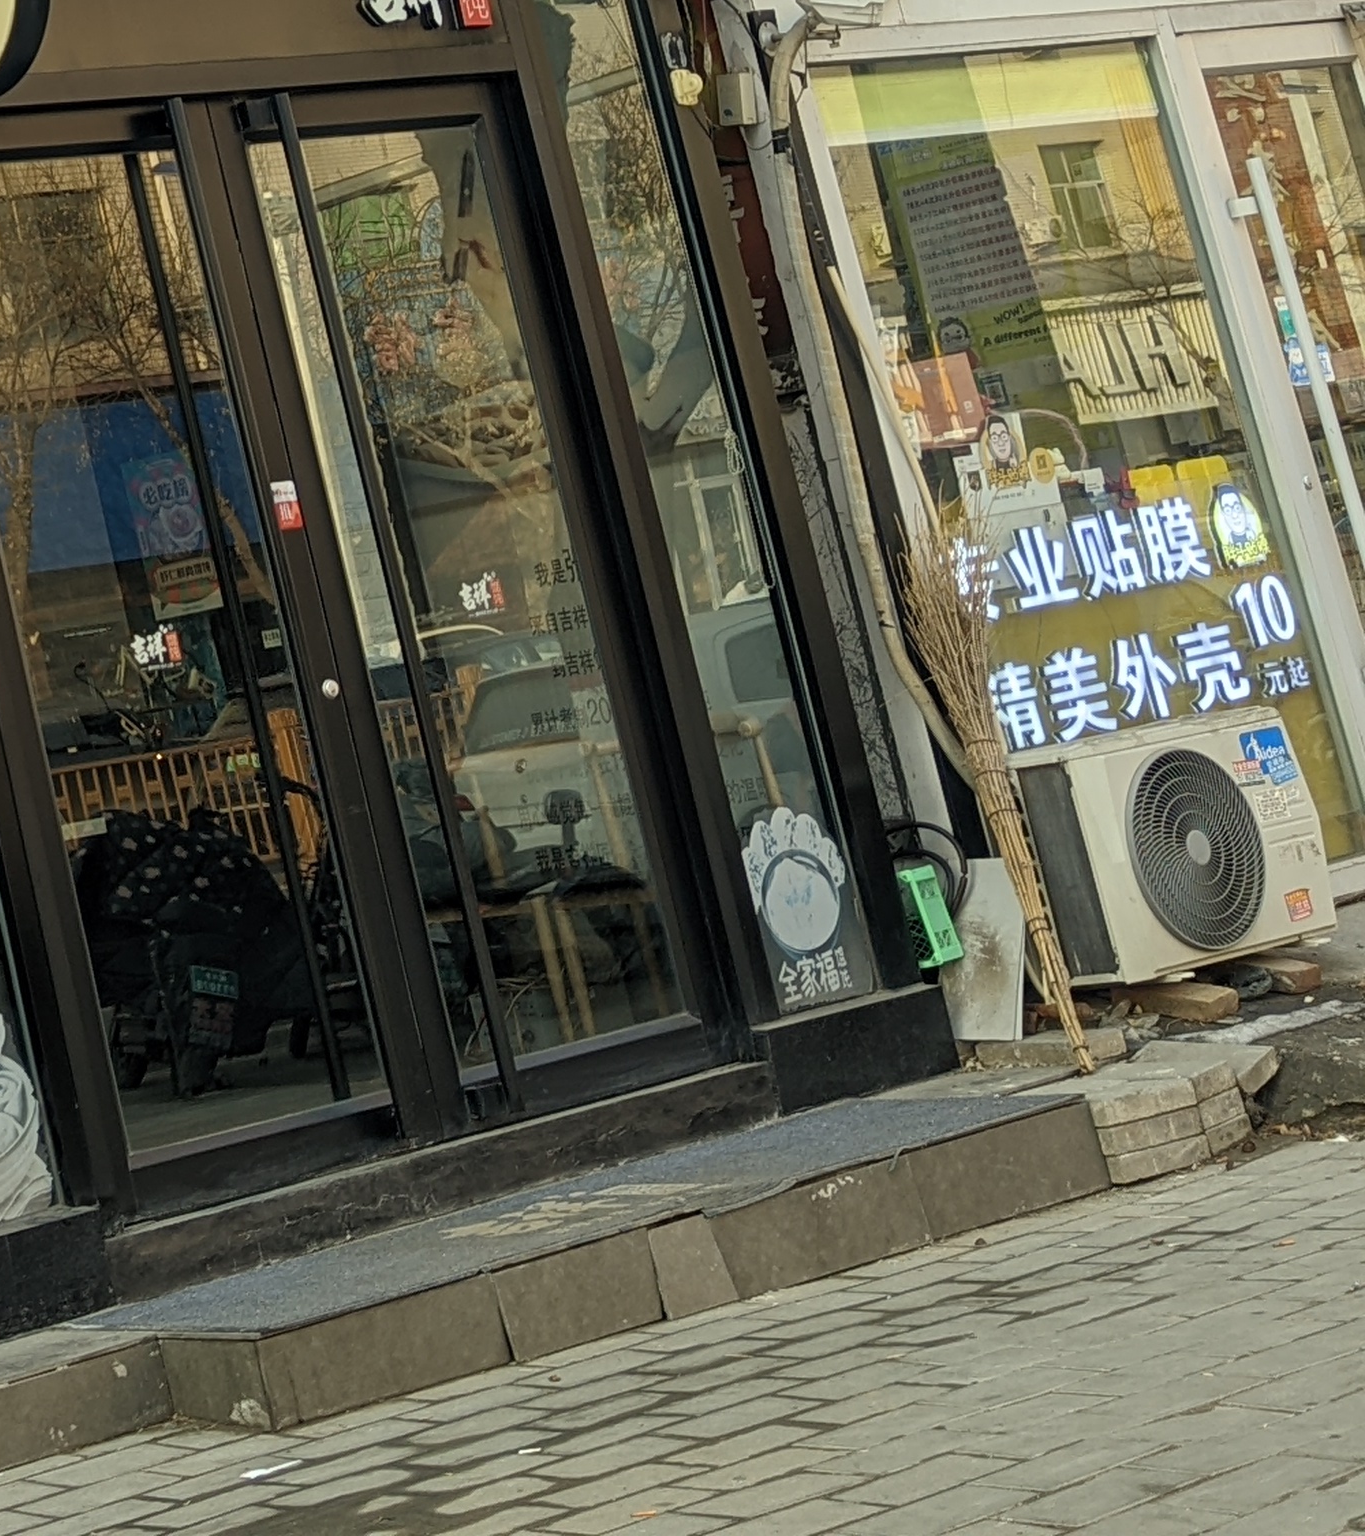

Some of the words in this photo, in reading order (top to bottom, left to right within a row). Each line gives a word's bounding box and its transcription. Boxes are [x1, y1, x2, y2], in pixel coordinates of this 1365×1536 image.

[1235, 574, 1298, 649] 10
[1258, 660, 1312, 699] 元起
[777, 948, 839, 1006] 全家福
